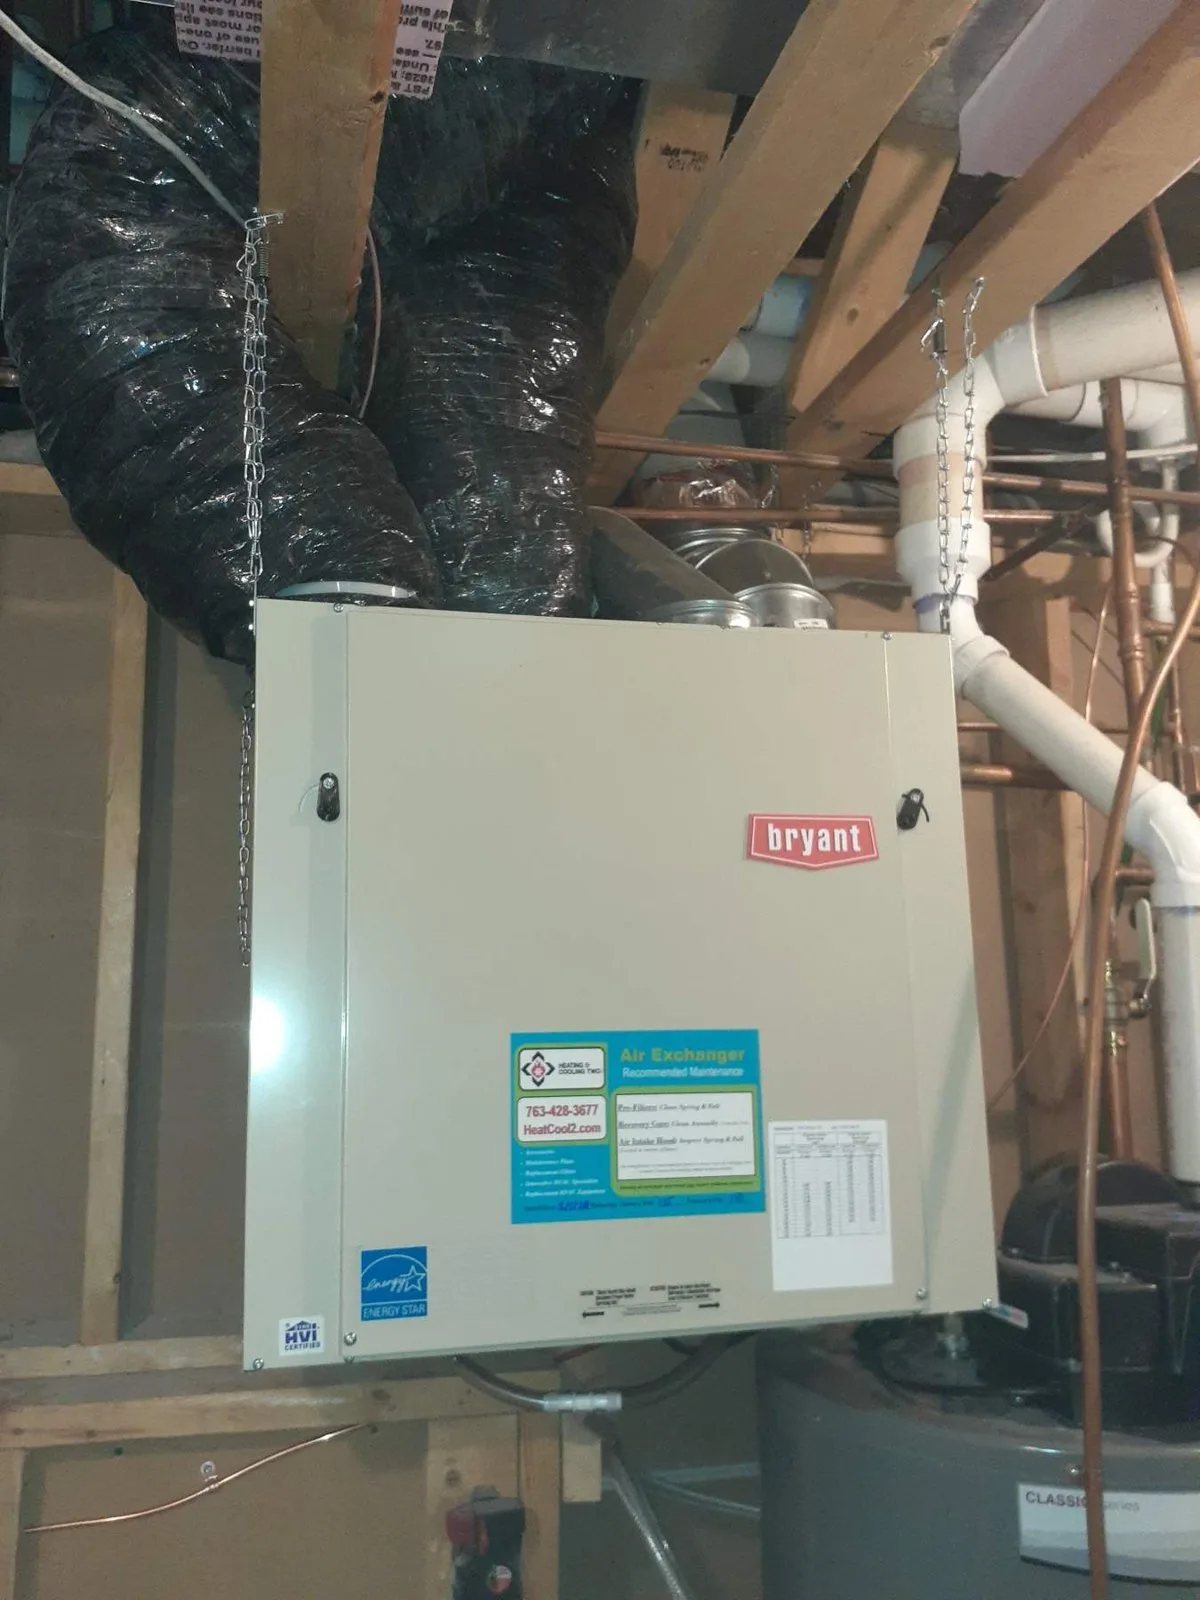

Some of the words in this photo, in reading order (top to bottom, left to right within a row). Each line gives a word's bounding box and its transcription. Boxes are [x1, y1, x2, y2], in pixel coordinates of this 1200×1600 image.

[199, 4, 225, 16] see
[205, 18, 242, 31] most
[216, 31, 231, 42] of
[235, 34, 260, 45] use
[396, 47, 420, 58] see
[768, 823, 862, 856] bryant
[621, 1048, 645, 1062] Air
[651, 1047, 745, 1065] Exchanger
[622, 1067, 688, 1078] Recommended
[689, 1066, 744, 1077] Maintenance
[526, 1104, 599, 1117] 763-428-3677
[523, 1122, 602, 1136] HeatCool2.com
[363, 1305, 400, 1318] ENERGY
[402, 1303, 426, 1315] STAR
[284, 1330, 317, 1345] HVI
[284, 1342, 321, 1351] CERTIFIED
